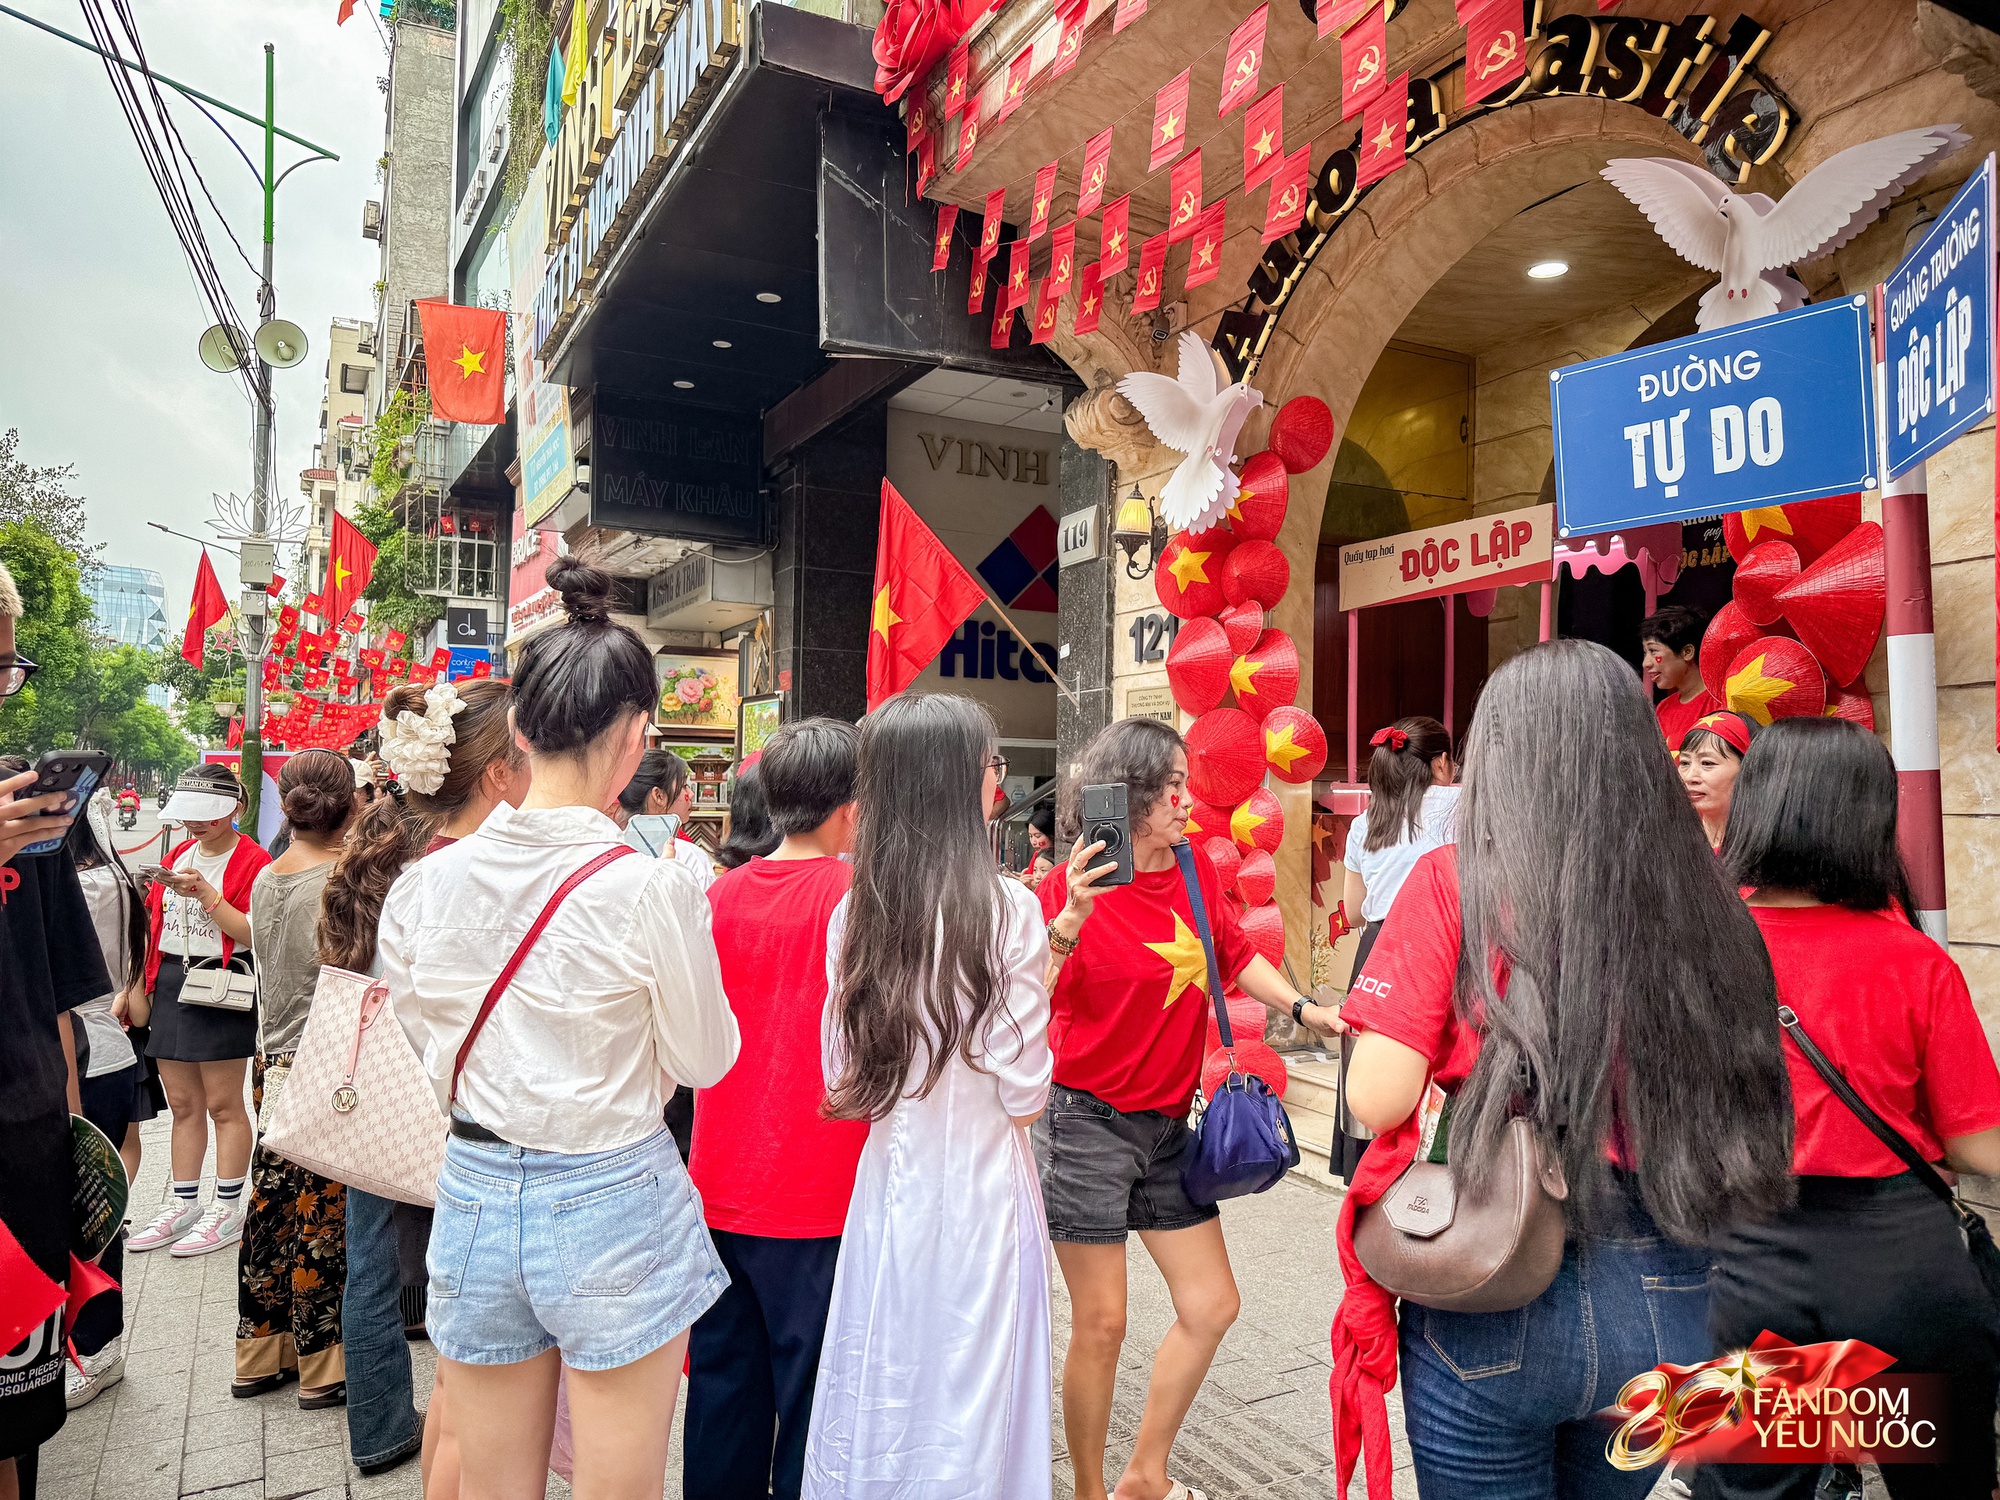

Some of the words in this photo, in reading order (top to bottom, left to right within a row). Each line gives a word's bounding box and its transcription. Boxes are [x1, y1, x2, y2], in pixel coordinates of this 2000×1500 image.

[1890, 265, 1928, 332] QUẢNG
[1929, 207, 1980, 292] TRƯỜNG
[1638, 350, 1761, 402] ĐƯỜNG
[1897, 326, 1931, 444] ĐỘC
[1935, 286, 1972, 416] LẬP
[600, 414, 677, 456] VINH
[917, 432, 1050, 485] VINH
[1623, 407, 1690, 498] TỰ
[1710, 396, 1784, 474] DO
[604, 470, 669, 508] MÁY
[675, 482, 753, 518] KHÂU
[1062, 519, 1088, 553] 119
[1399, 537, 1460, 584] ĐỘC
[1470, 519, 1532, 569] LẬP
[1129, 613, 1179, 663] 121
[28, 1358, 59, 1380] PIECES
